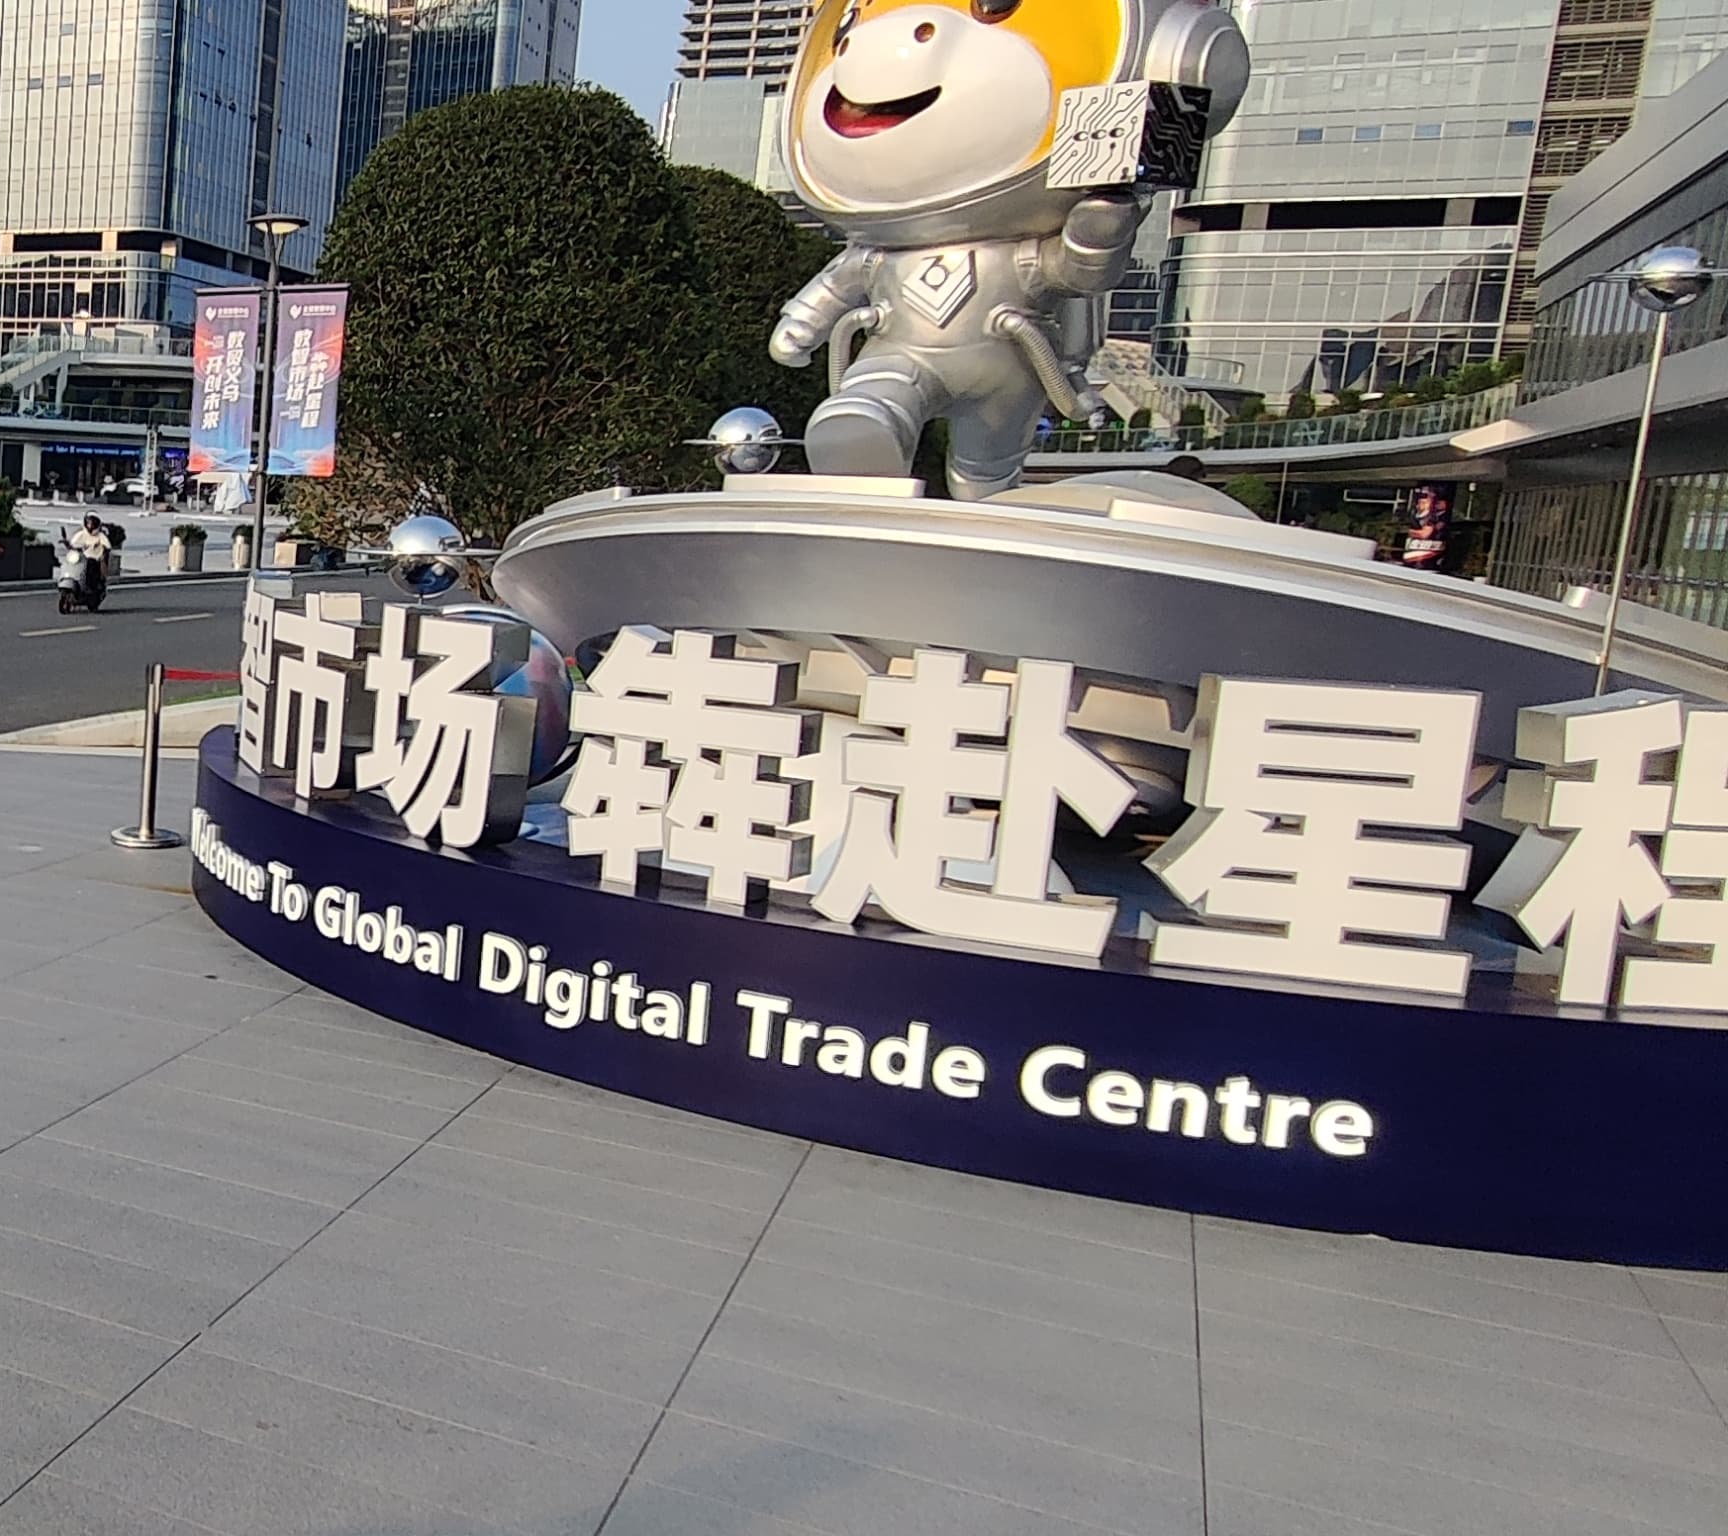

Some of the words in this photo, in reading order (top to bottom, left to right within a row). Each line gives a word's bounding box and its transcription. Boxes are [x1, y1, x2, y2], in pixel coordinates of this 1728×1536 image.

[190, 806, 266, 902] Welcome
[268, 860, 311, 922] To
[313, 885, 464, 982] Global
[478, 931, 712, 1030] Digital
[736, 989, 988, 1099] Trade
[1018, 1045, 1375, 1158] Centre
